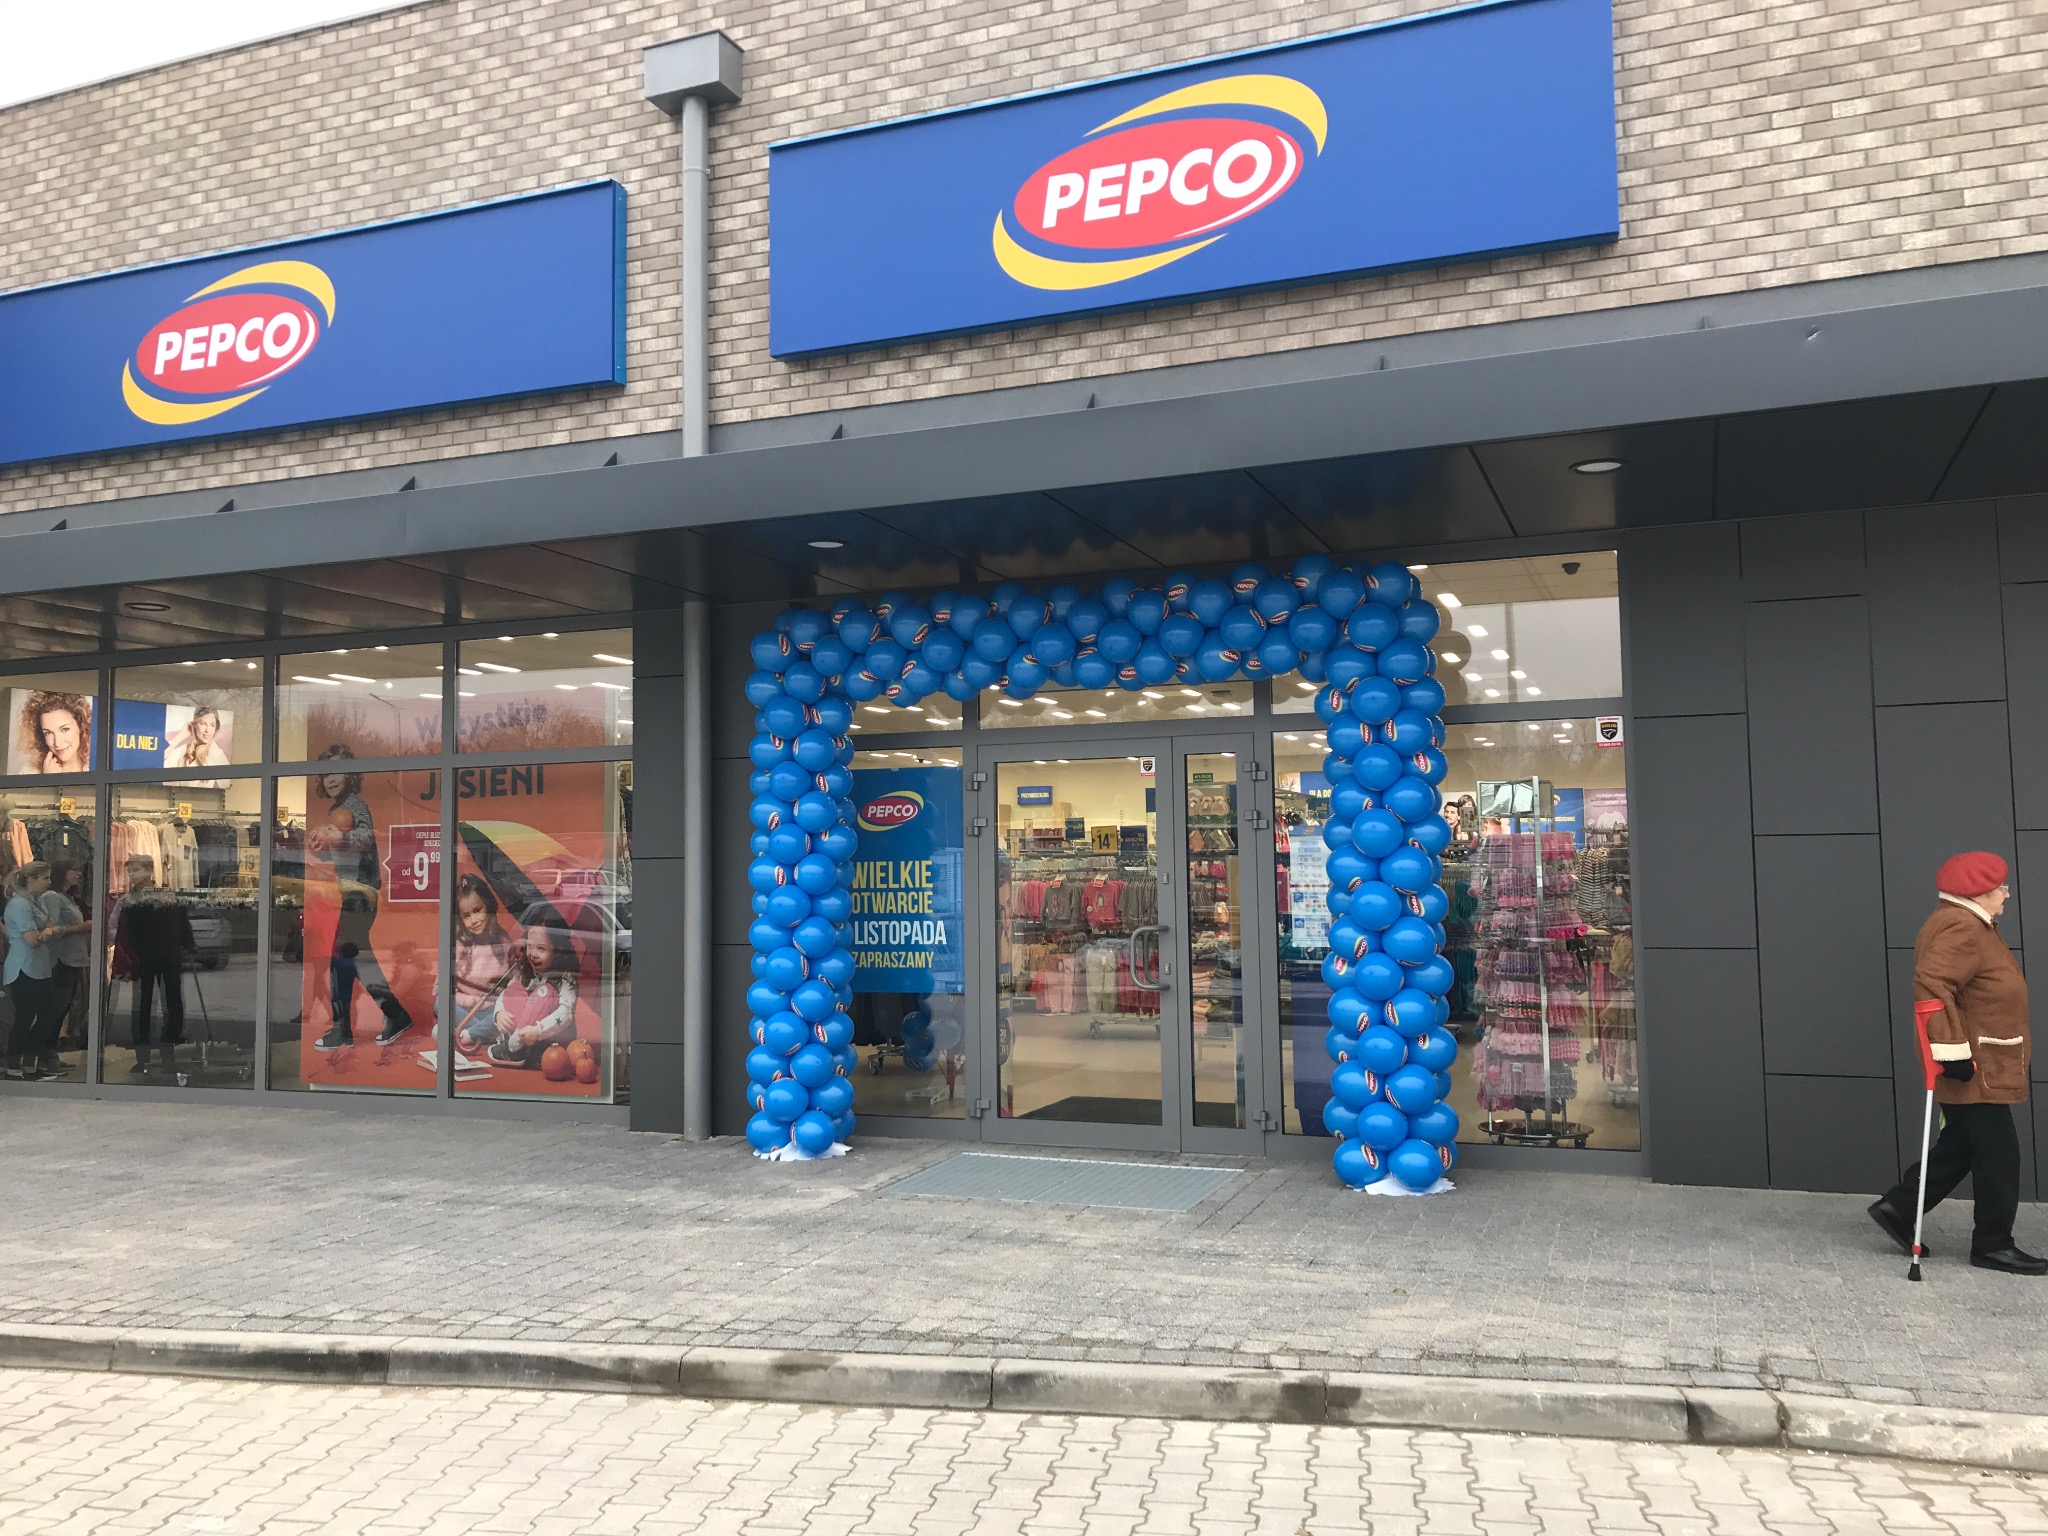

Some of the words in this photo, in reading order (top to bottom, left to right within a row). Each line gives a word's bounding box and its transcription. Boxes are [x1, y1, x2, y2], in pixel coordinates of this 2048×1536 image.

[1042, 139, 1272, 229] PEPCO
[154, 312, 301, 375] PEPCO
[1168, 588, 1185, 597] PEPCO
[915, 628, 928, 642] PEPCO
[1224, 650, 1239, 661] PEPCO
[1332, 690, 1340, 708] PEPCO
[117, 734, 135, 749] DLA
[138, 736, 157, 751] NIEJ
[420, 765, 544, 800] JSIENI
[868, 805, 913, 818] PEPCO
[1097, 833, 1110, 849] 14
[402, 867, 411, 877] od
[414, 851, 429, 891] 9
[430, 851, 441, 863] 99
[852, 860, 933, 889] WIELKIE
[852, 891, 933, 914] OTWARCIE
[1411, 895, 1420, 915] PEPCO
[854, 920, 947, 945] LISTOPADA
[1356, 940, 1368, 958] PEPCO
[1366, 1147, 1375, 1165] PEPCO
